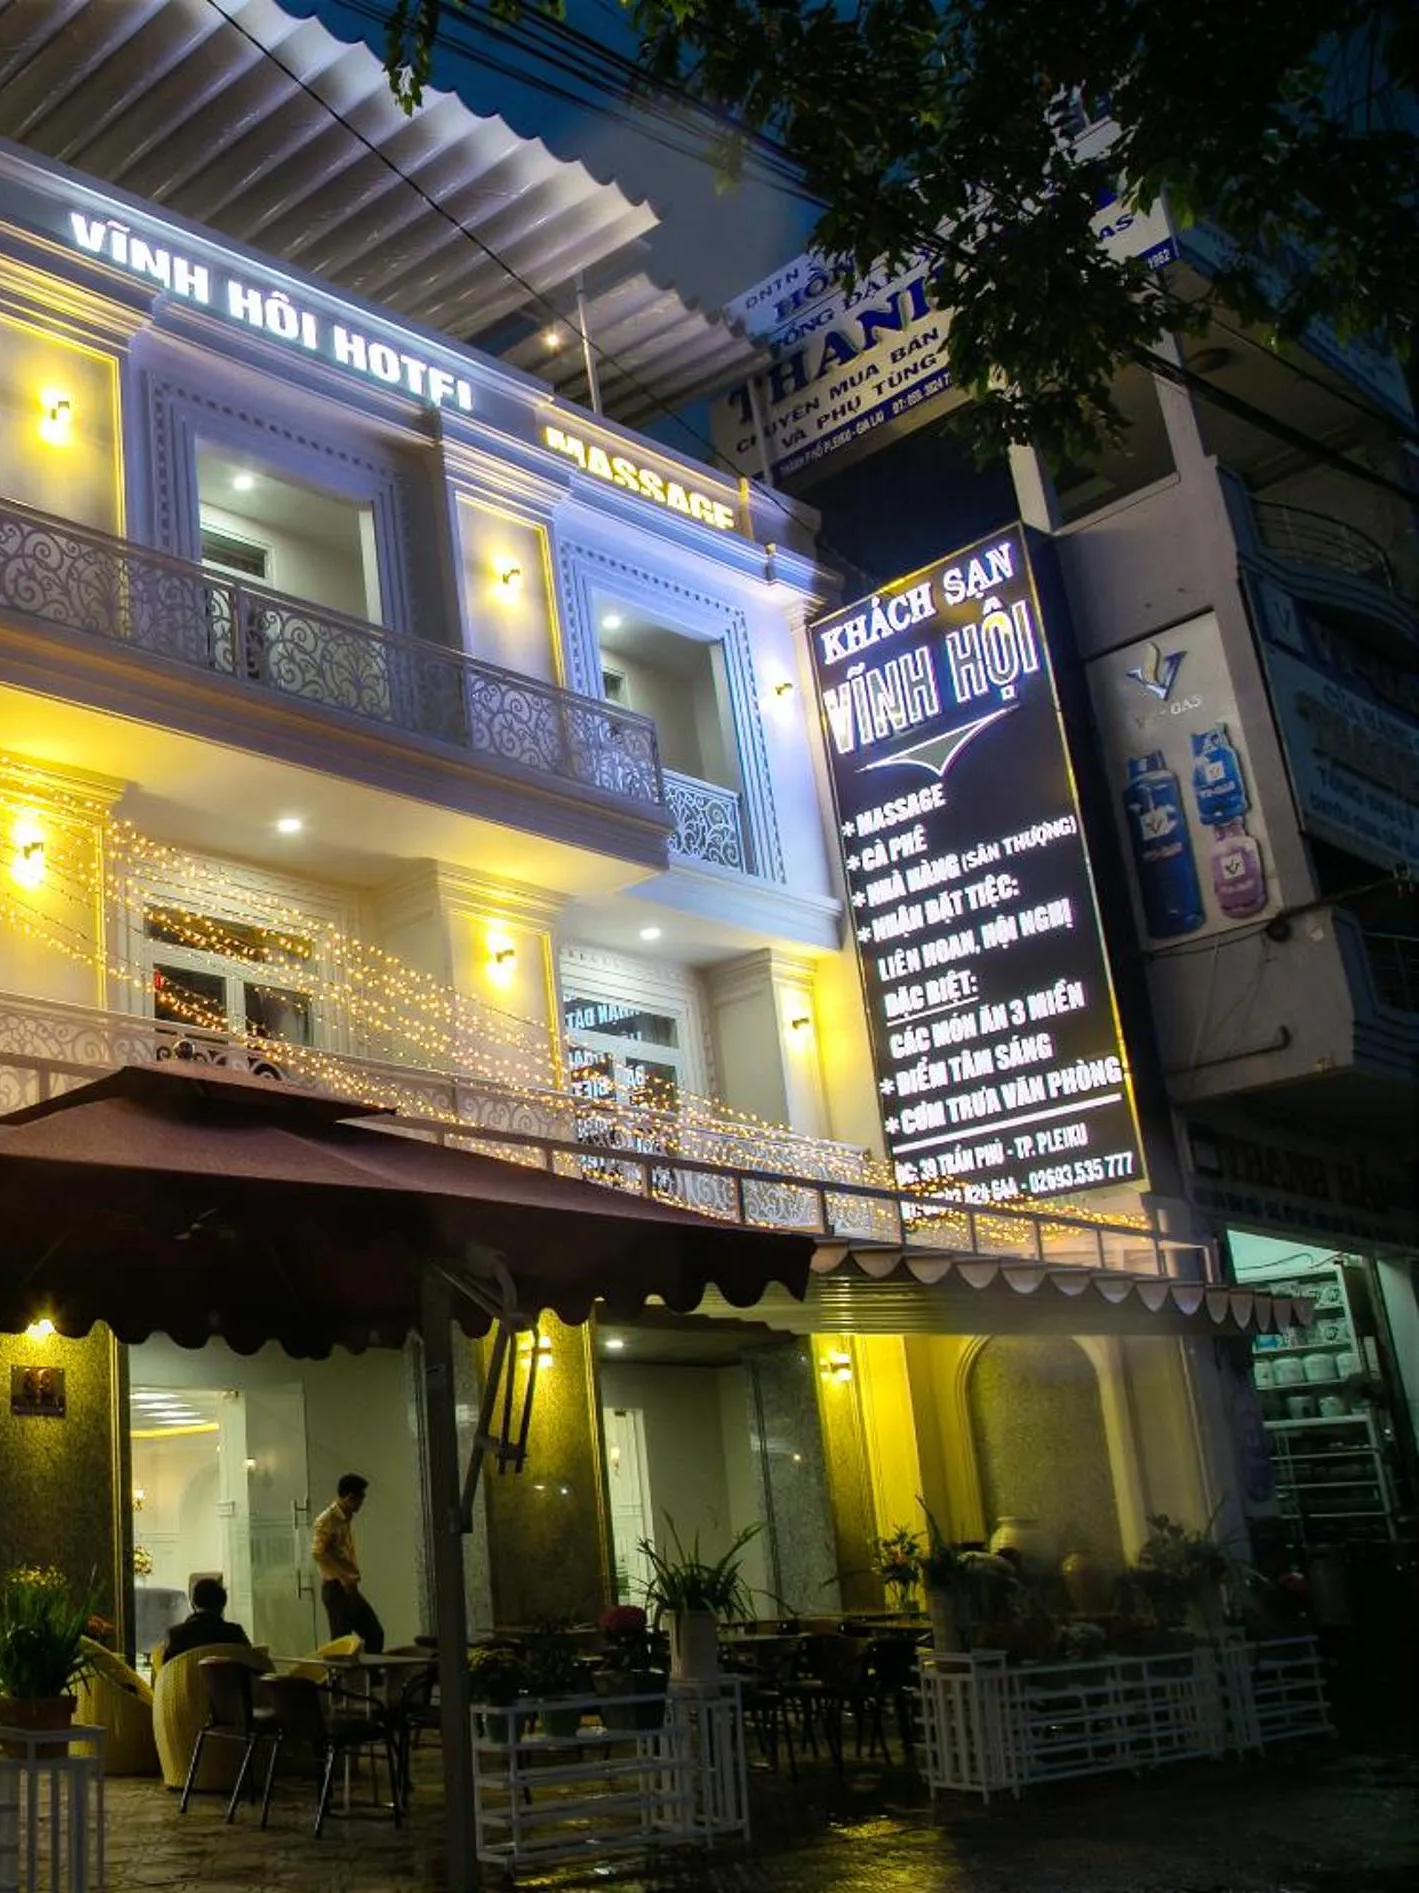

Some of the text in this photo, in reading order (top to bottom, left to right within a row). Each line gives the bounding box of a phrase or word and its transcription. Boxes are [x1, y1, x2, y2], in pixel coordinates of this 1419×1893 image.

[1098, 212, 1135, 241] AS
[70, 213, 211, 304] VĨNH
[745, 268, 800, 309] DNTN
[830, 363, 881, 400] MUA
[820, 543, 1014, 665] KHÁCH SẠN
[823, 598, 1040, 754] VĨNH HỘI
[856, 783, 947, 837] MASSAGE
[861, 824, 928, 871] CÀ PHÊ
[866, 869, 908, 907] NHÀ
[907, 853, 962, 890] HÀNG
[872, 874, 1020, 943] NHẬN ĐẶT TIỆC:
[877, 945, 921, 981] LIÊN
[981, 914, 1018, 949] HỘI
[1019, 897, 1073, 937] NGHỊ
[884, 970, 978, 1018] ĐẶC BIỆT:
[889, 1027, 931, 1059] CÁC
[932, 1011, 977, 1047] MÓN
[1011, 999, 1027, 1025] 3
[949, 1048, 994, 1083] TÂM
[995, 1033, 1053, 1071] SÁNG
[946, 1087, 1002, 1123] TRƯA
[1001, 1074, 1046, 1109] VĂN
[1047, 1056, 1123, 1099] PHÒNG
[1014, 1134, 1036, 1159] TP.
[1036, 1122, 1089, 1156] PLEIKU
[1105, 1151, 1134, 1176] 777
